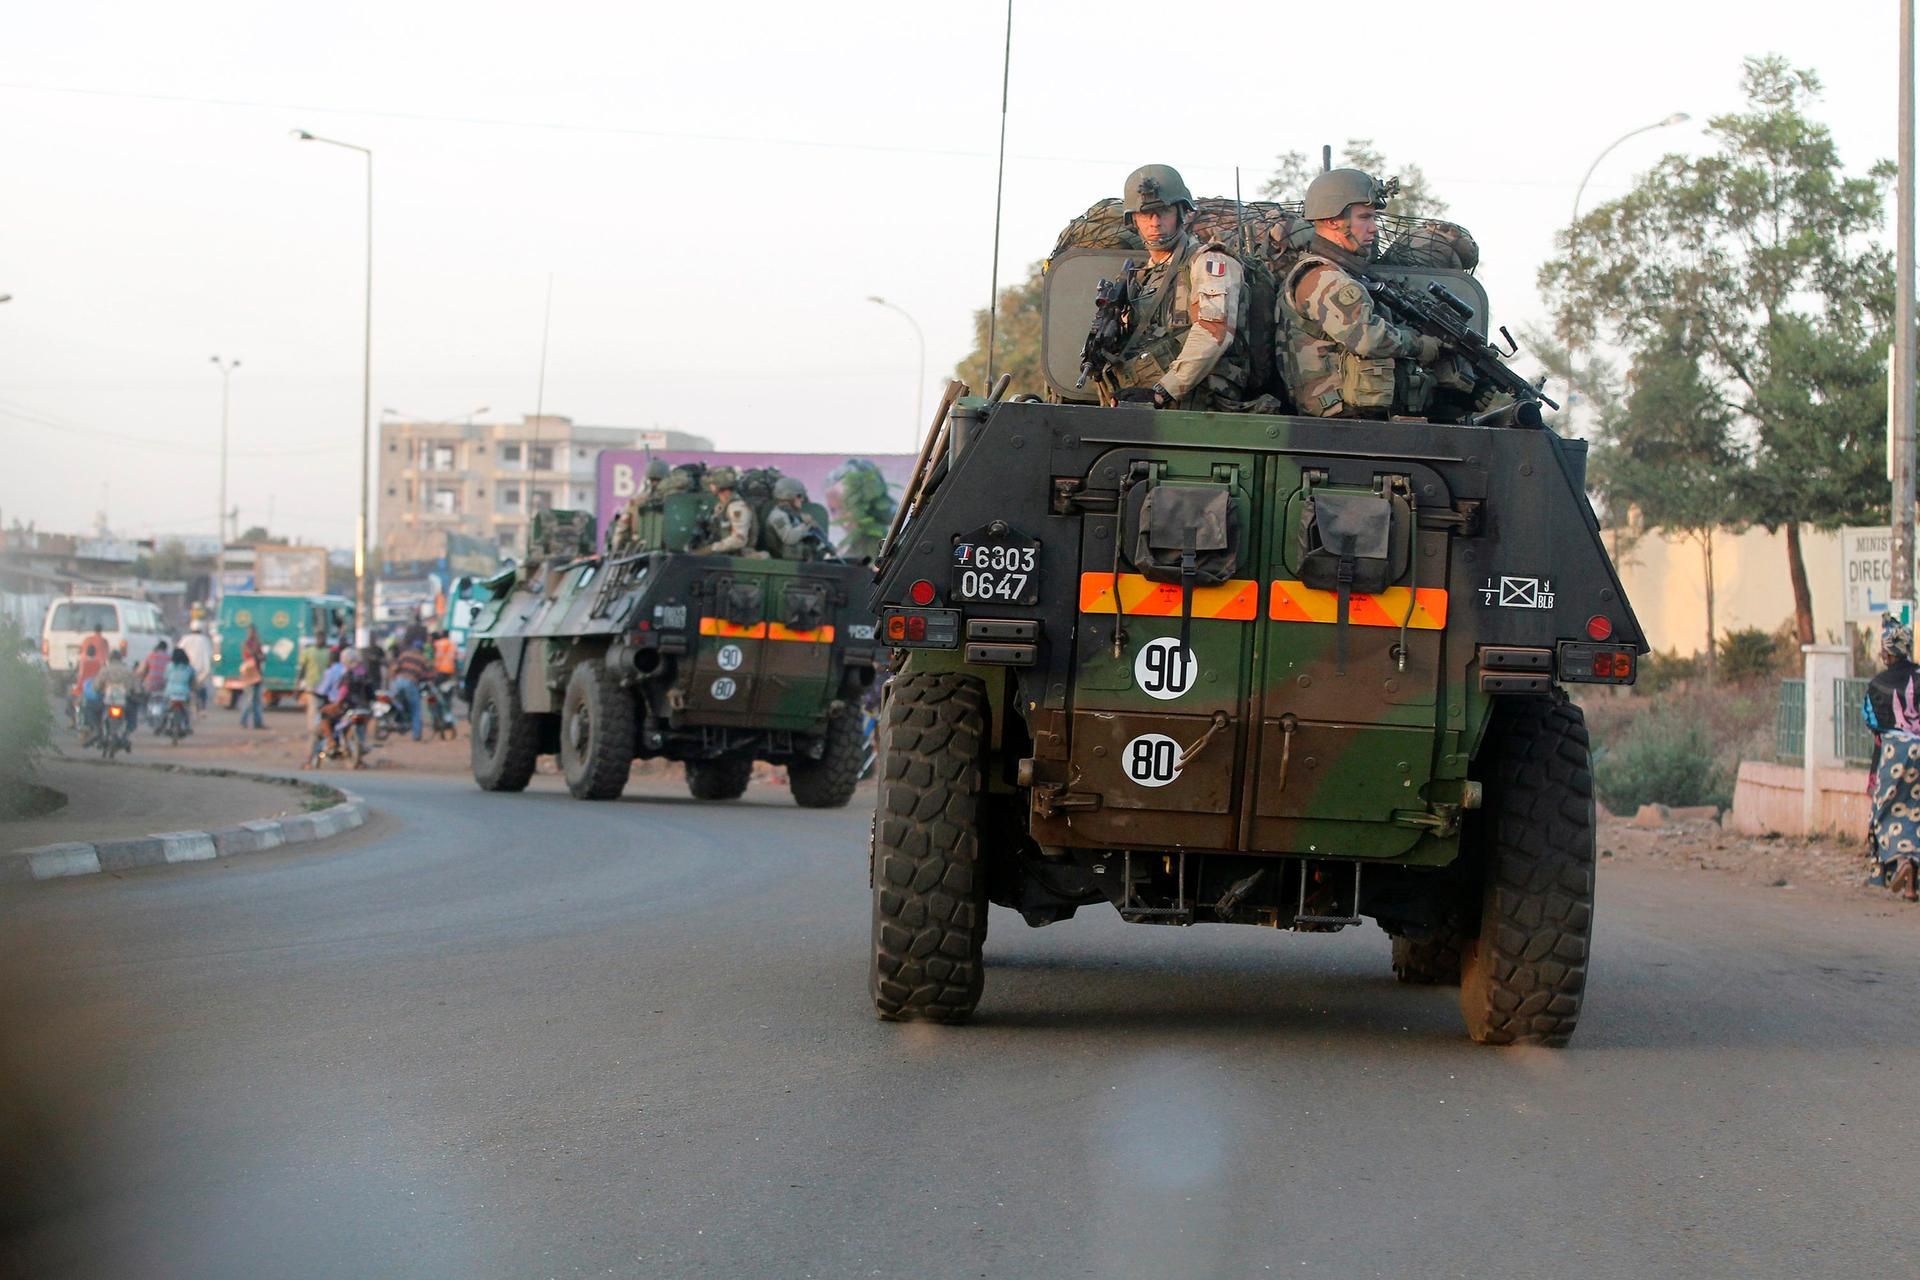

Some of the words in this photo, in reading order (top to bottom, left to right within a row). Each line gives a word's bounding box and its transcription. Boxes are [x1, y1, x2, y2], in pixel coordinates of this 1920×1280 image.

[962, 571, 1028, 600] 0647
[1487, 577, 1492, 588] 1
[1485, 592, 1492, 606] 2
[1537, 595, 1554, 609] BLB
[721, 648, 740, 667] 90
[1144, 644, 1188, 692] 90
[714, 681, 733, 697] 80
[1131, 739, 1175, 781] 80
